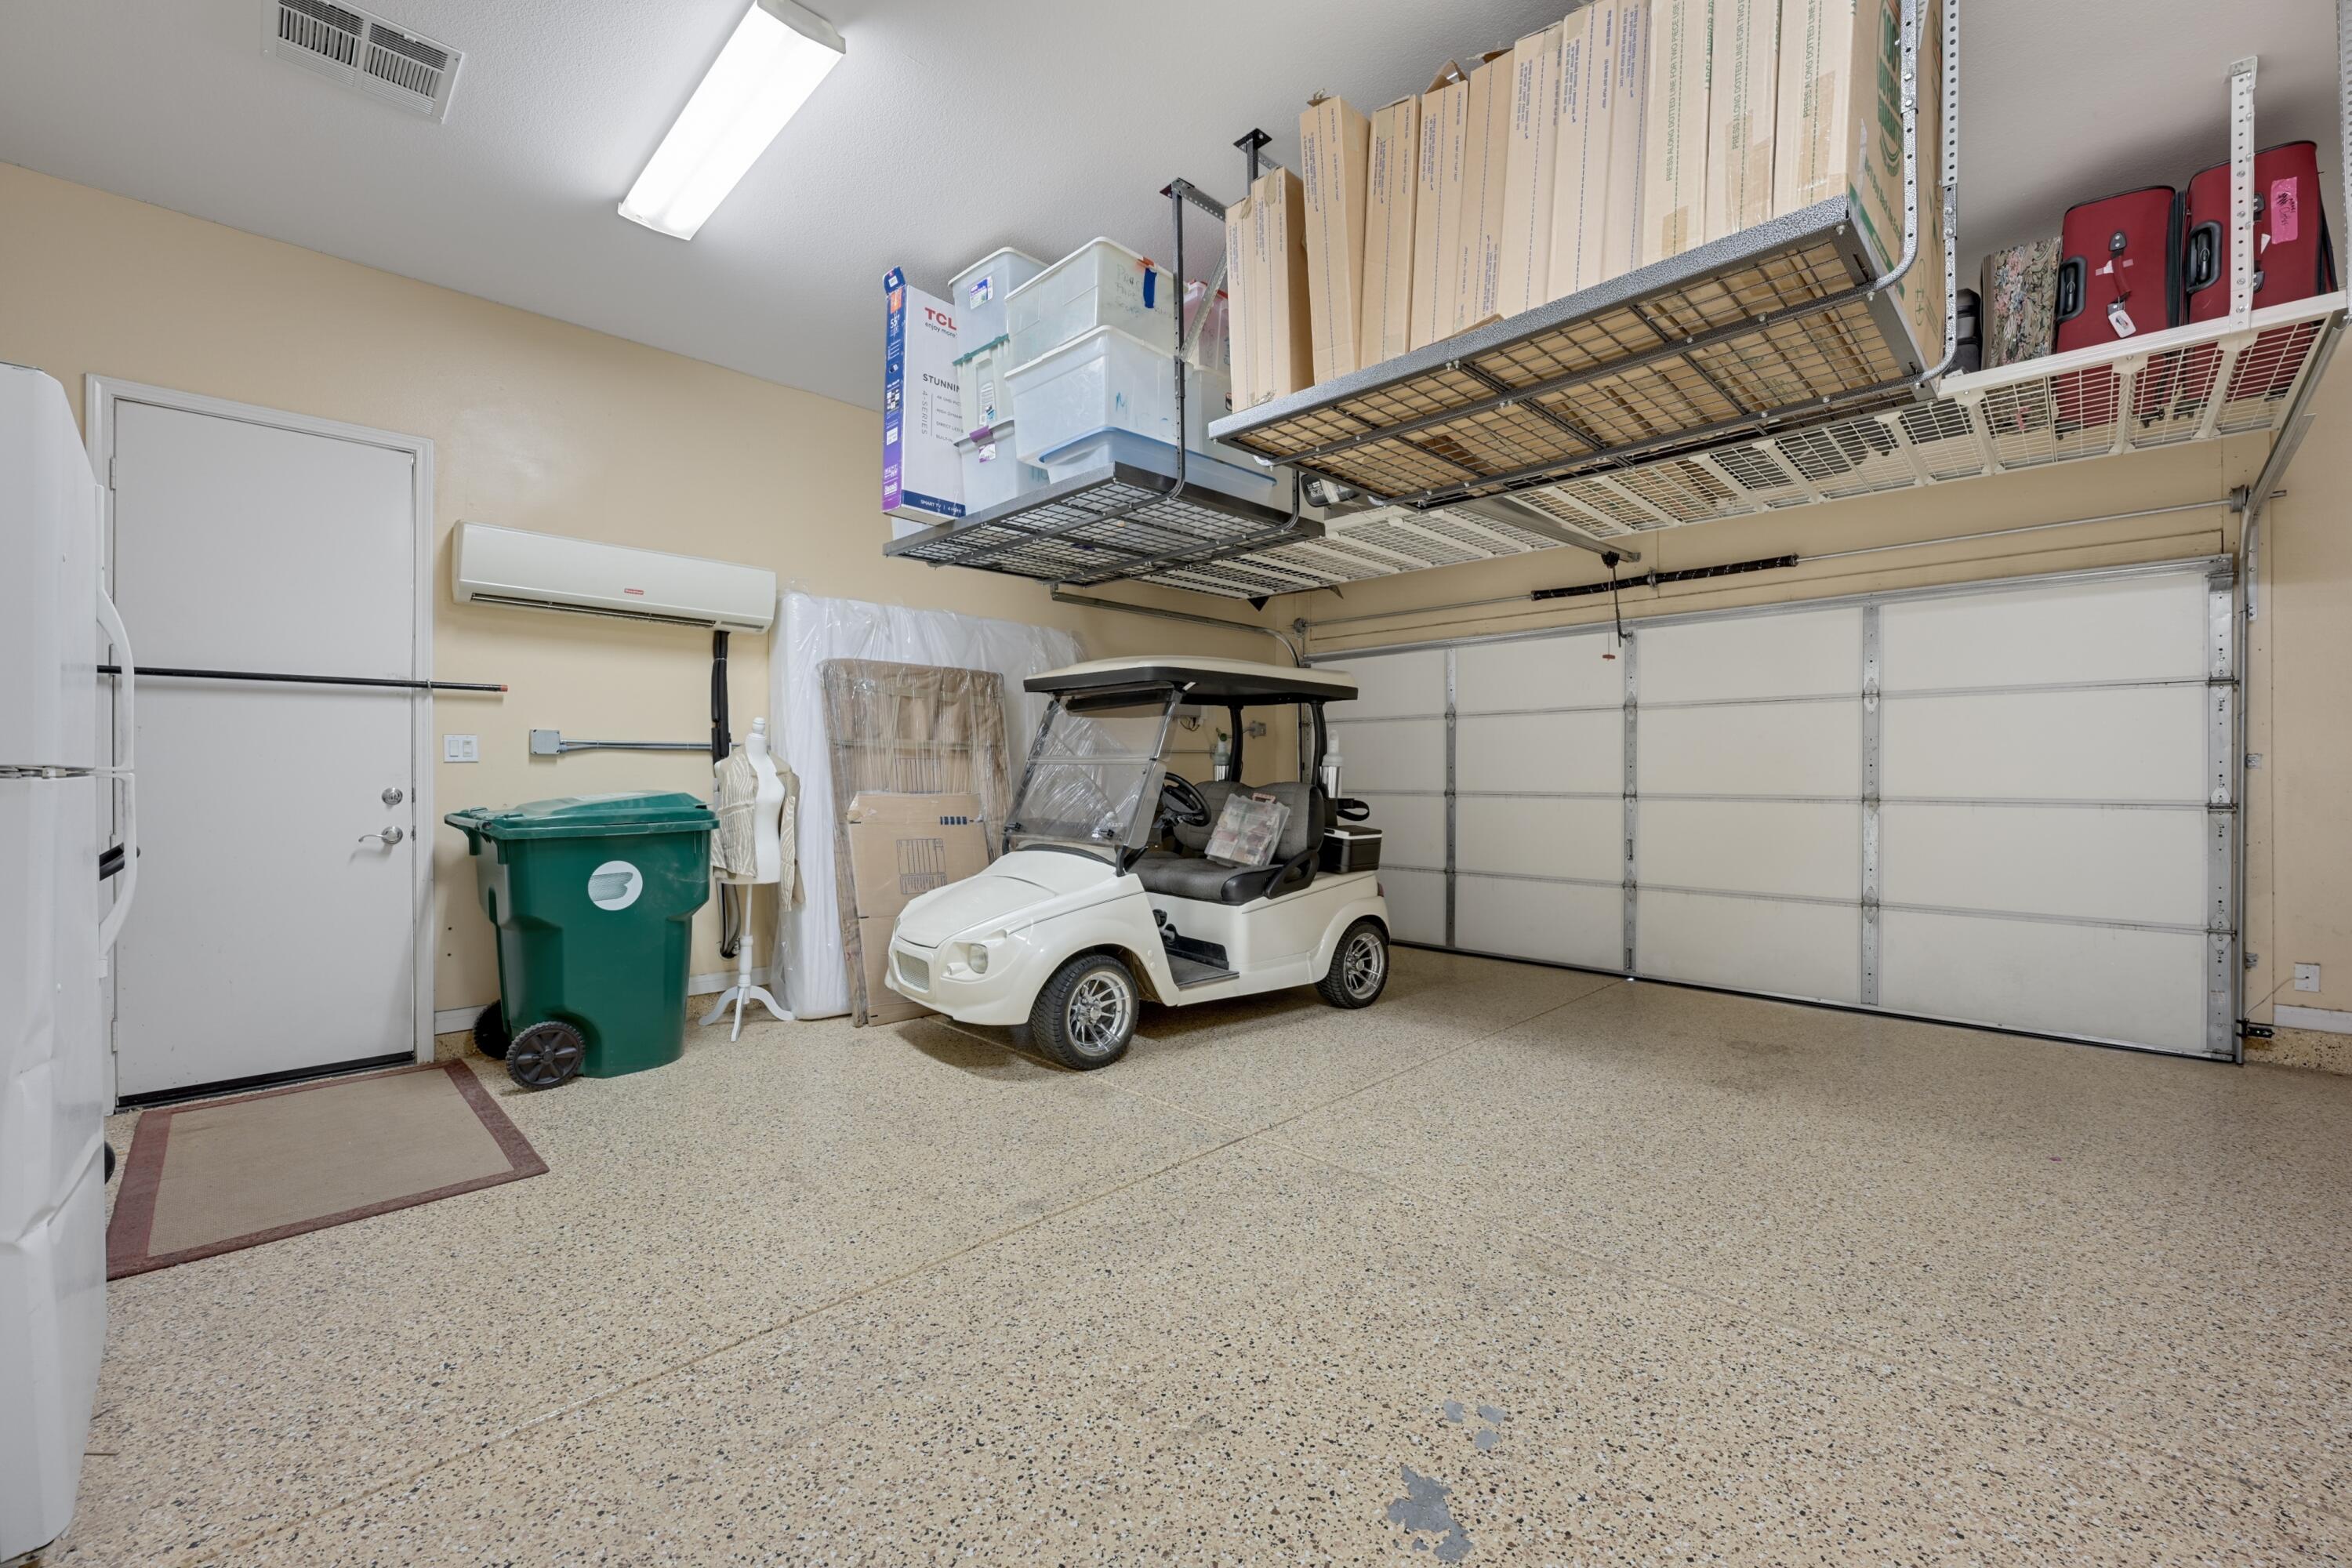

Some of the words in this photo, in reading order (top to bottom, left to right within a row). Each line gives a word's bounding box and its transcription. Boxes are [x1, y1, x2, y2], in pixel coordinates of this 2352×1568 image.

[924, 307, 957, 330] TCL
[924, 321, 940, 332] enjoy
[941, 328, 956, 338] more
